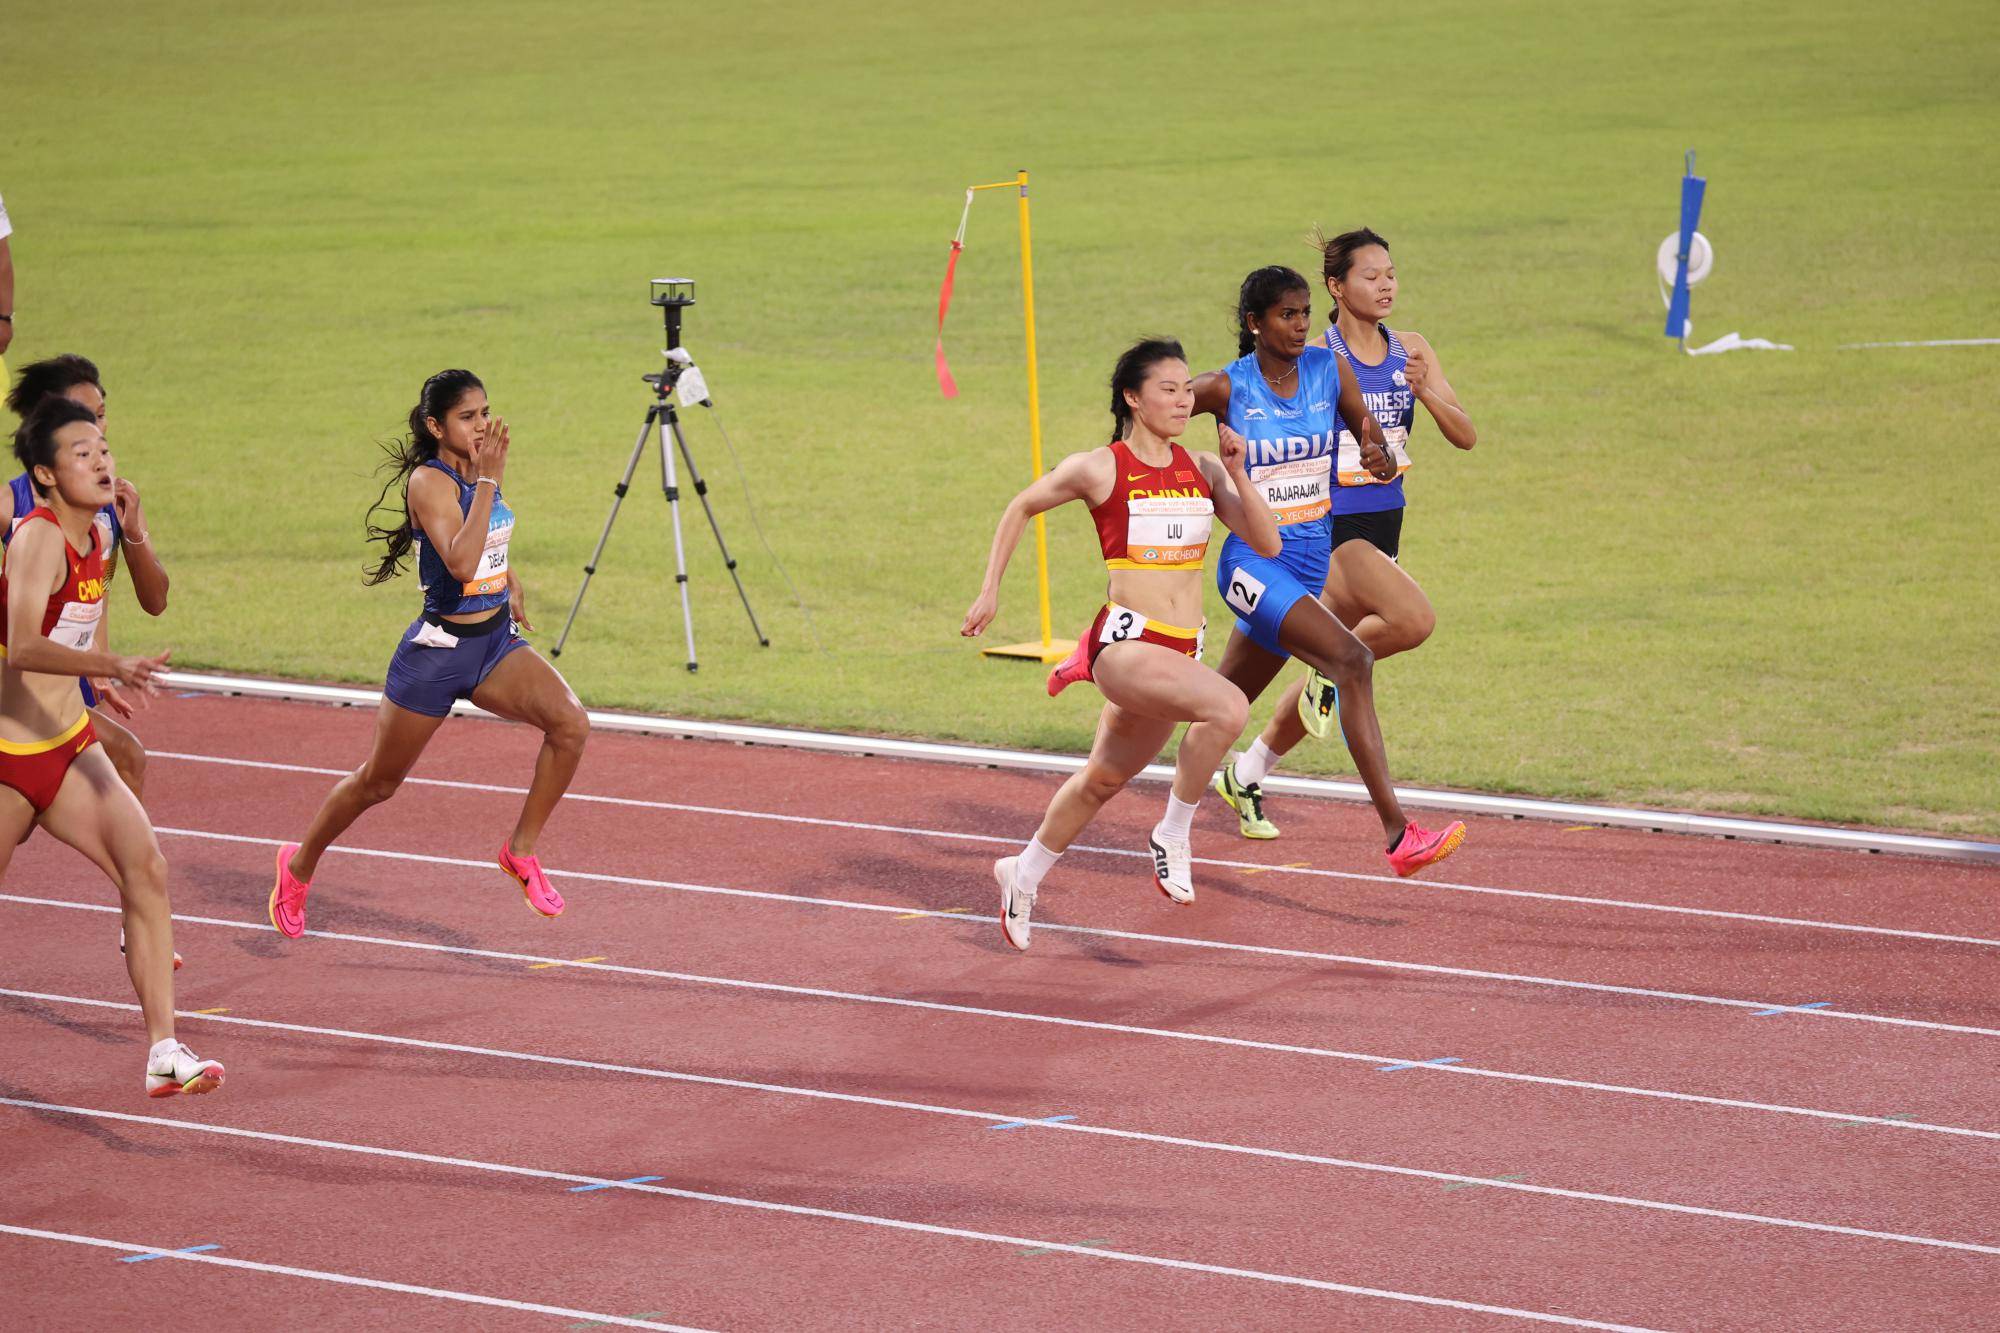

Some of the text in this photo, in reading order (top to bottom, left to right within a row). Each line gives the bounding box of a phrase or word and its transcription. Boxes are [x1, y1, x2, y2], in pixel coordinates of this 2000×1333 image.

[1362, 391, 1410, 410] INESE
[1248, 429, 1334, 465] INDIA
[1268, 482, 1320, 502] RAJARAJAN
[1286, 505, 1325, 520] YECHEON
[1167, 523, 1183, 539] LIU
[1161, 548, 1200, 561] YECHEON
[79, 578, 102, 601] CHIN
[1232, 581, 1257, 608] 2
[1112, 612, 1134, 642] 3
